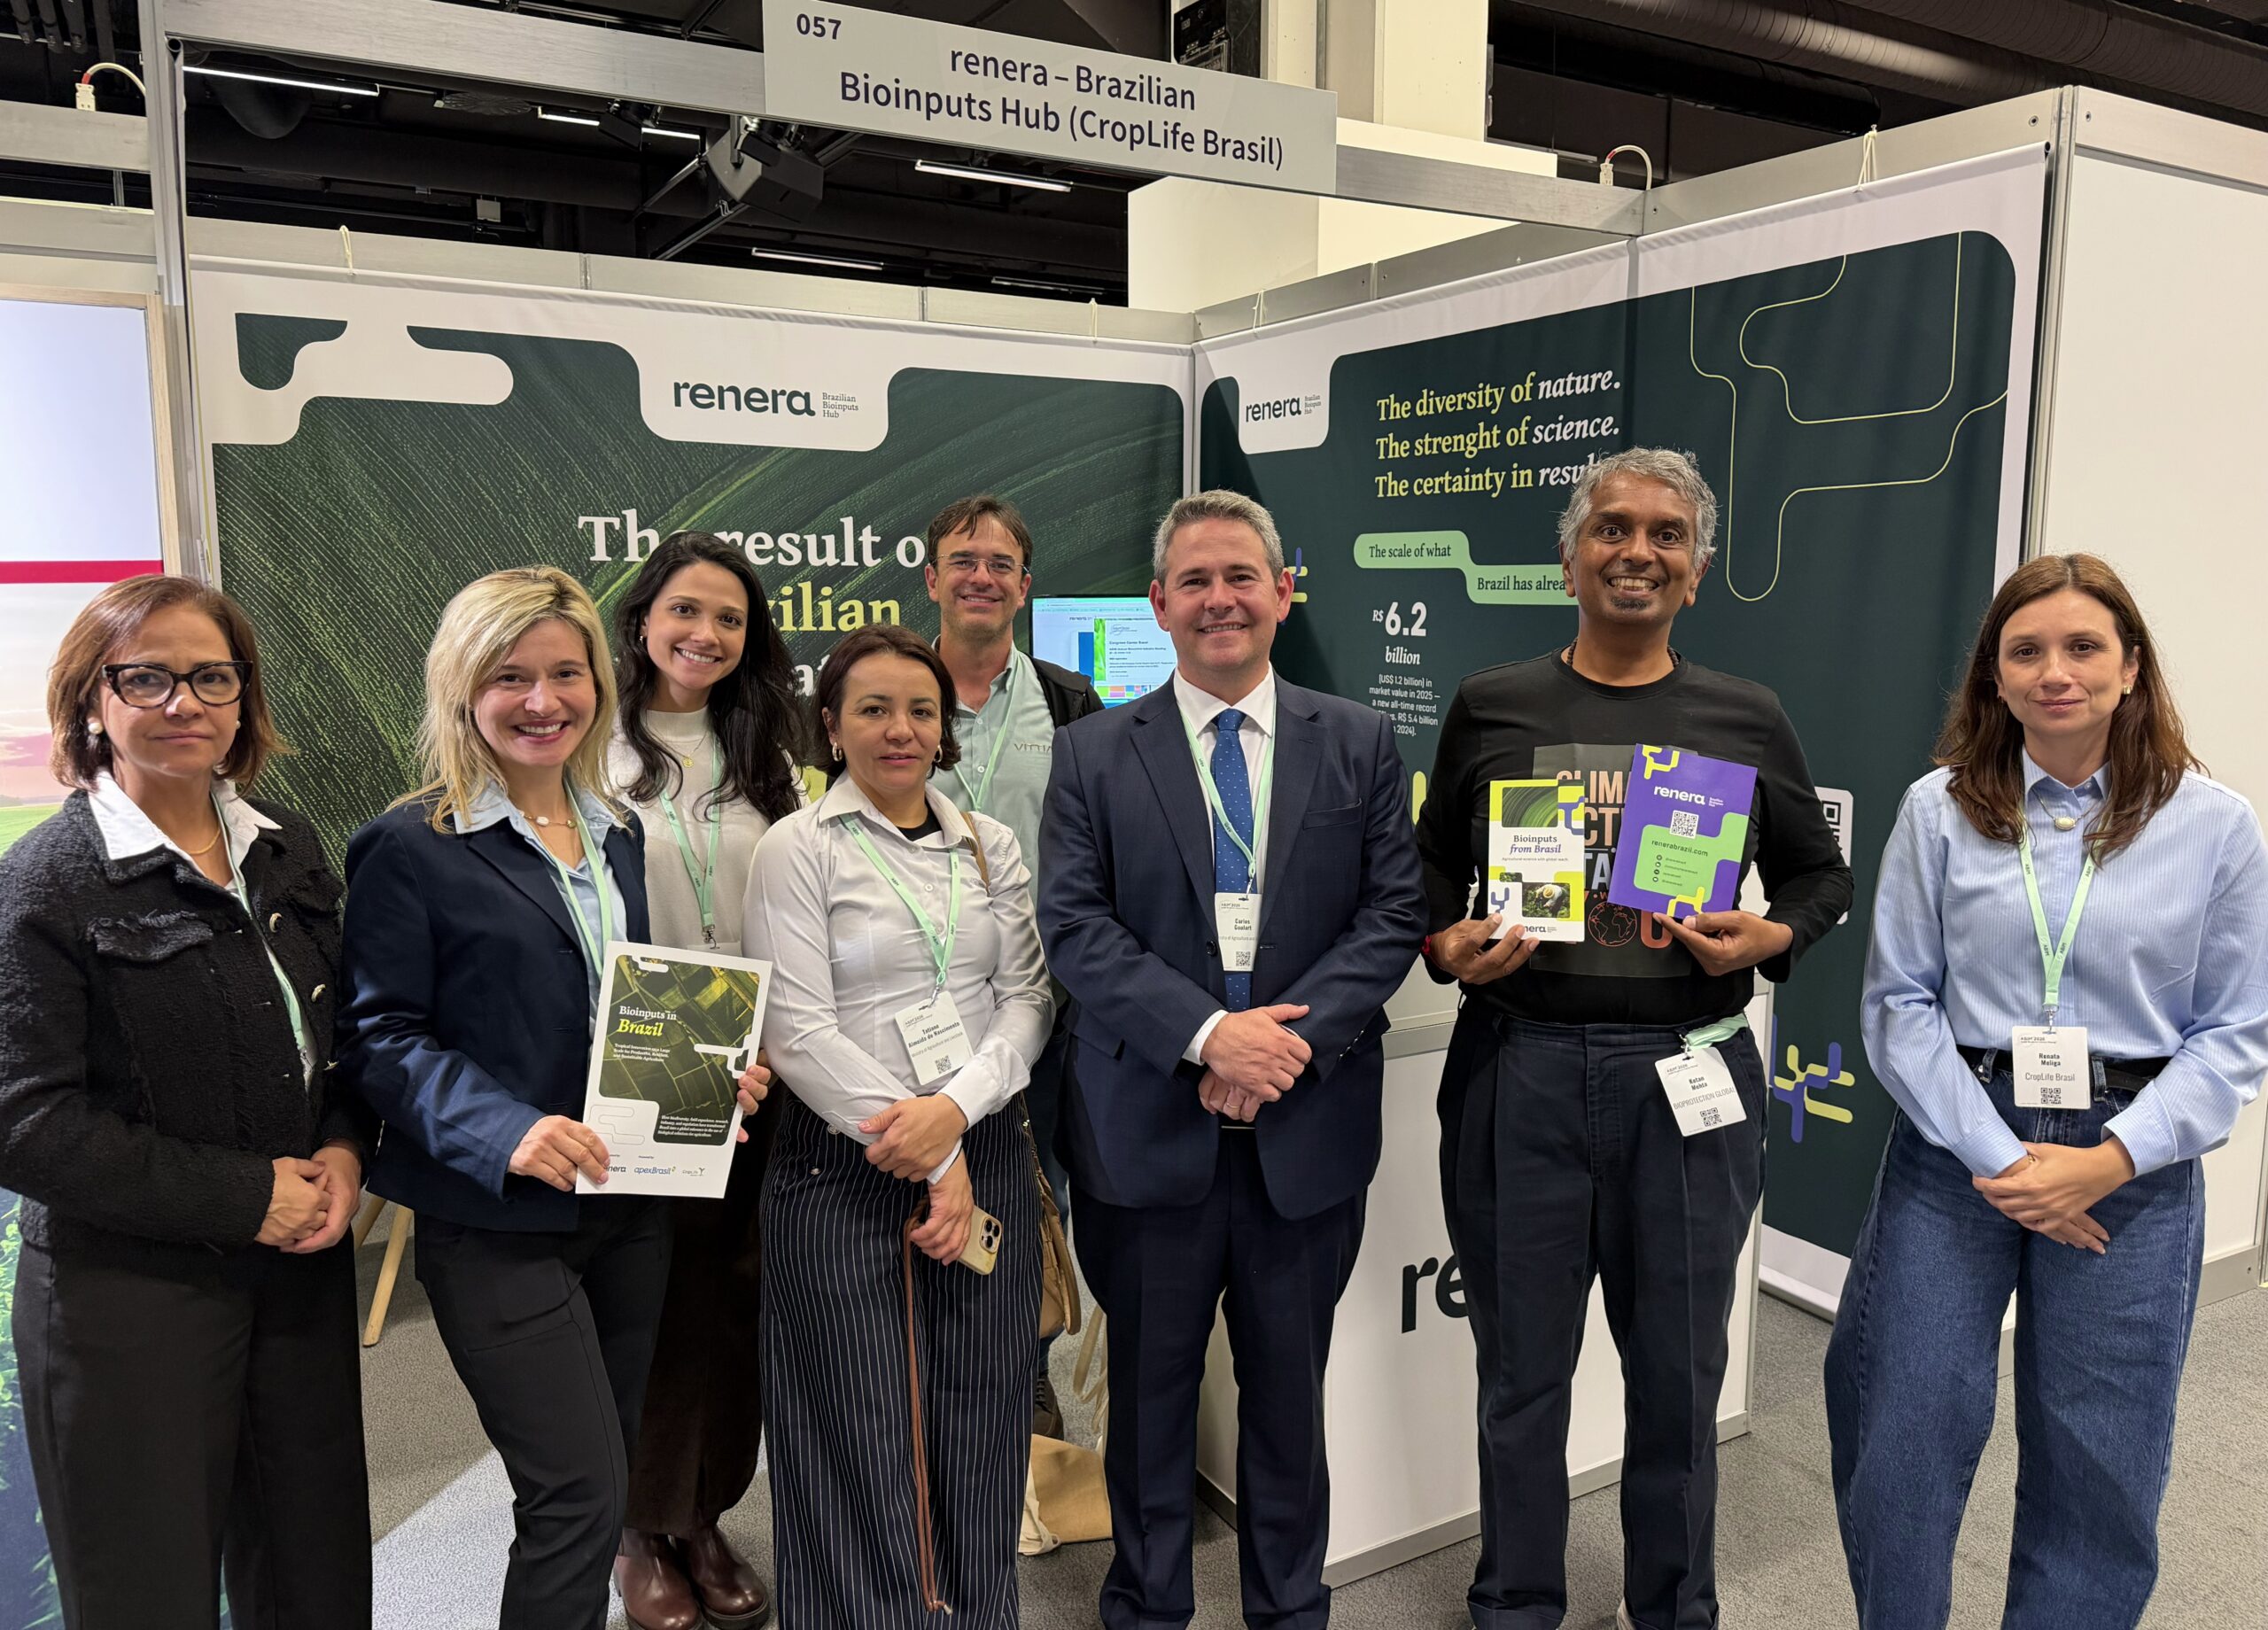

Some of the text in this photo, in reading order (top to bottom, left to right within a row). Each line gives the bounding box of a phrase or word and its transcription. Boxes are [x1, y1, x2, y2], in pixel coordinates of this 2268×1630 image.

[796, 12, 843, 41] 057
[951, 47, 1049, 87] renera
[1076, 65, 1196, 112] Brazilian
[841, 71, 1284, 172] Bioinputs Hub (CropLife Brasil)
[673, 382, 816, 416] renera
[822, 392, 857, 403] Brazilian
[1377, 369, 1621, 422] The diversity of nature.
[822, 400, 859, 412] Bioinputs
[822, 409, 840, 418] Hub
[1246, 397, 1301, 423] renera
[1376, 415, 1619, 460] The strenght of science.
[1375, 471, 1409, 498] The
[1413, 467, 1506, 498] certainty
[1511, 462, 1533, 488] in
[579, 508, 682, 562] Th
[715, 516, 882, 568] result
[1369, 543, 1451, 558] The scale of what
[1477, 574, 1566, 591] Brazil has alrea
[1372, 602, 1427, 637] R$ 6.2
[1385, 645, 1421, 665] billion
[1425, 678, 1433, 687] in
[1369, 687, 1391, 696] market
[1391, 688, 1409, 698] value
[1409, 689, 1416, 698] in
[1417, 690, 1433, 700] 2025
[1371, 698, 1437, 713] a new all-time record
[1398, 712, 1407, 723] R$
[1408, 713, 1418, 724] 5.4
[1418, 715, 1439, 726] billion
[1654, 786, 1705, 805] renera
[1513, 834, 1557, 844] Bioinputs
[1510, 843, 1562, 855] from Brasil
[1651, 840, 1708, 857] renerabrazil.com
[618, 1005, 677, 1021] Bioinputs in
[617, 1019, 664, 1036] Brazil
[2024, 1072, 2075, 1082] CropLife Brasil
[1673, 1086, 1736, 1110] BIOPROTECTION GLOBAL
